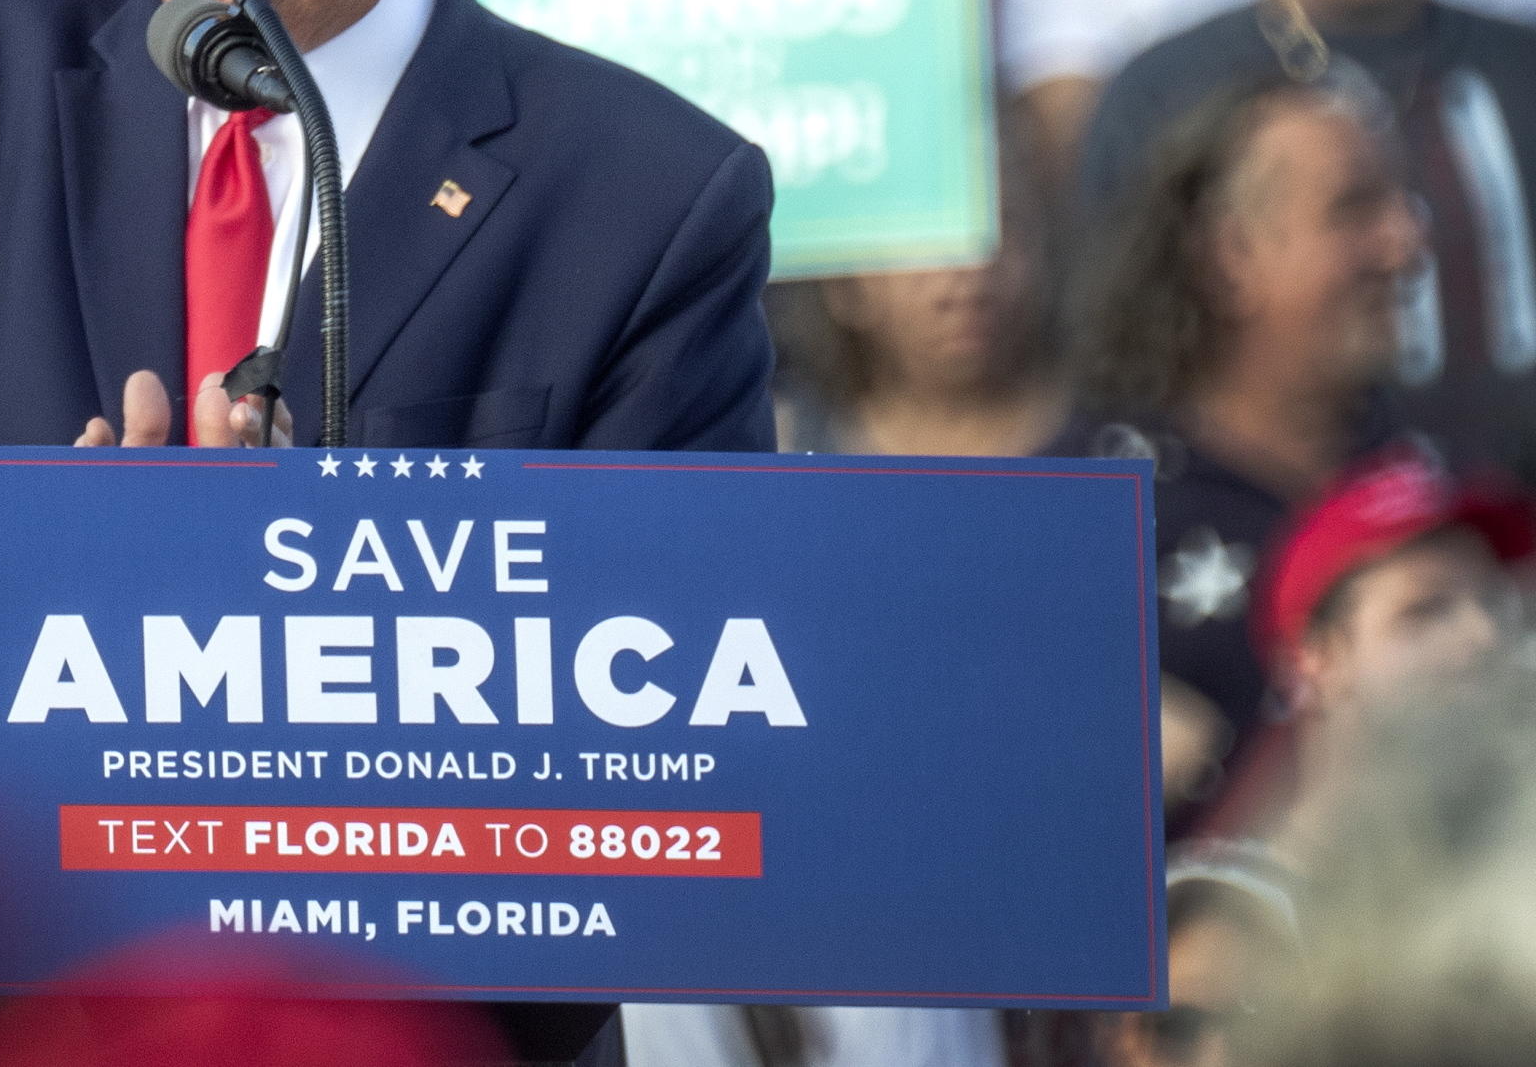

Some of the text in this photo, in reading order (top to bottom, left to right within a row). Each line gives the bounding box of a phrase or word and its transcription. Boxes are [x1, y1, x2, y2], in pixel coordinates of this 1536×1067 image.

[263, 517, 550, 594] SAVE
[6, 614, 808, 728] AMERICA
[102, 749, 717, 782] PRESIDENT DONALD J. TRUMP
[97, 819, 722, 861] TEXT FLORIDA TO 88022
[209, 898, 617, 941] MIAMI, FLORIDA
